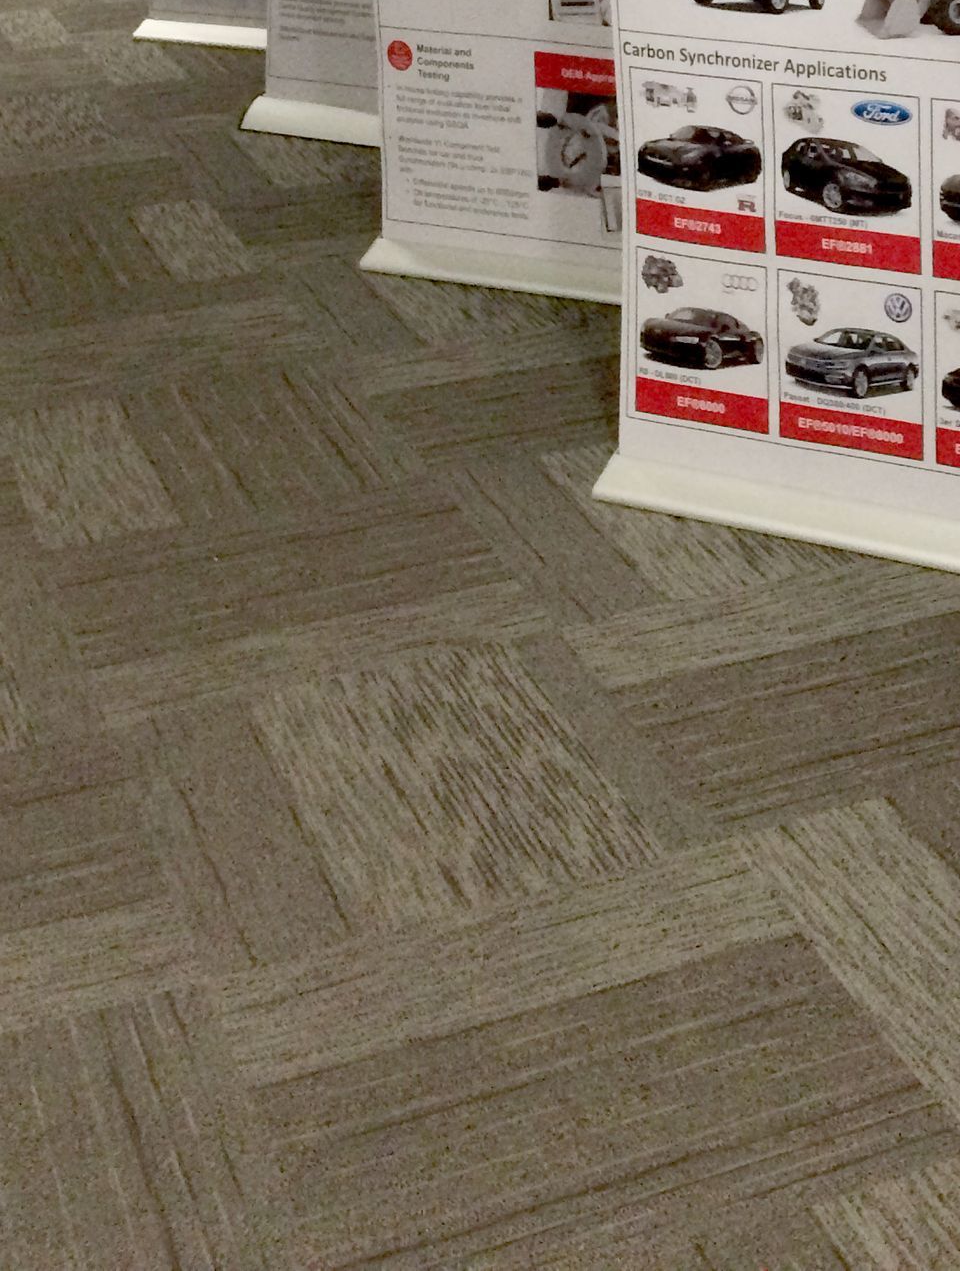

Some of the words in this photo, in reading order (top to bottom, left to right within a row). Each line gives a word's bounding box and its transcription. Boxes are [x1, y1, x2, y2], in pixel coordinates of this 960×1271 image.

[622, 41, 675, 62] Carbon
[680, 48, 779, 71] Synchronizer
[784, 59, 887, 82] Applications
